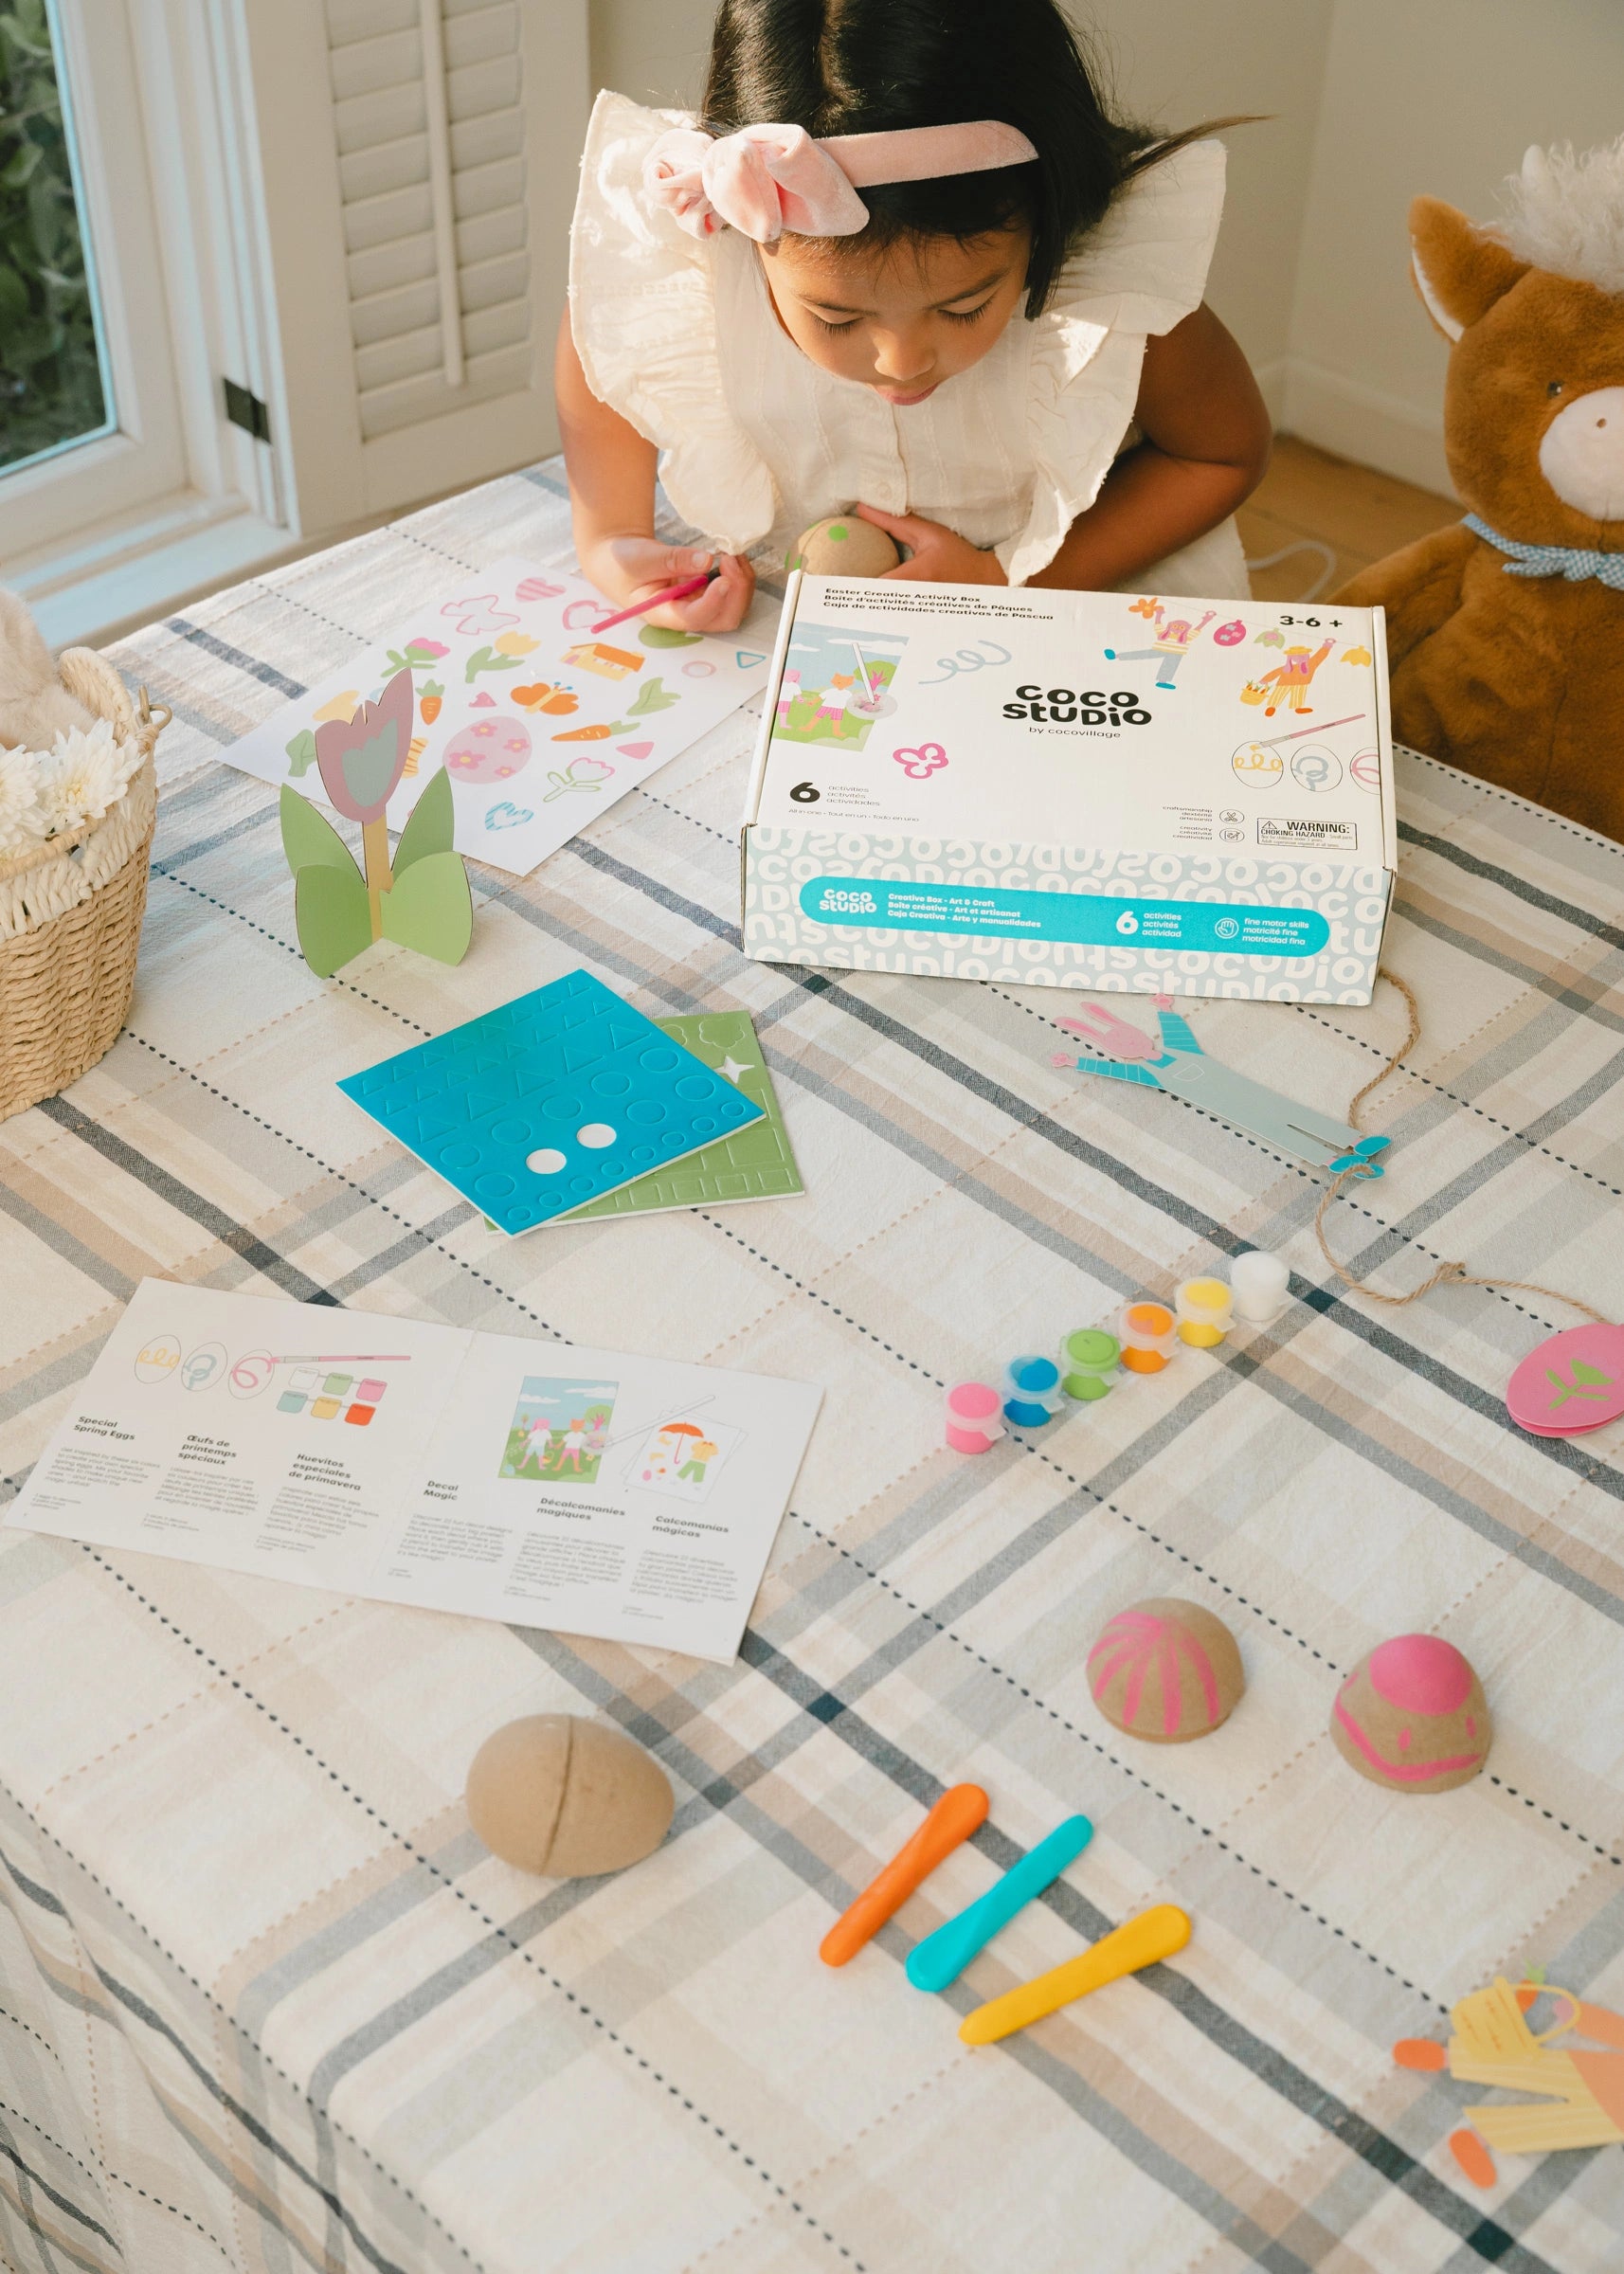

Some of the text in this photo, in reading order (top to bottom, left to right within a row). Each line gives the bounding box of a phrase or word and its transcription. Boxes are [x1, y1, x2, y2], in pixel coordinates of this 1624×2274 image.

[824, 587, 862, 596] Easter
[863, 590, 911, 599] Creative
[913, 593, 958, 602] Activity
[822, 601, 849, 609] Caja
[868, 604, 935, 614] actividades
[938, 607, 992, 617] creativas
[1012, 612, 1055, 621] Pascua
[918, 600, 971, 609] créatives
[991, 604, 1033, 613] Pâques
[1279, 615, 1321, 627] 3-6
[1048, 728, 1121, 739] cocovillage
[789, 782, 821, 803] 6
[826, 798, 880, 806] actividades
[1260, 828, 1294, 837] CHOKING
[1287, 821, 1350, 834] WARNING:
[888, 893, 925, 903] Creative
[927, 894, 943, 904] Box
[949, 896, 964, 906] Art
[972, 898, 996, 908] Craft
[888, 901, 910, 911] Boîte
[911, 903, 947, 912] créative
[955, 906, 968, 914] Art
[969, 907, 979, 915] et
[980, 907, 1020, 918] artisanat
[1144, 911, 1182, 921] activities
[887, 910, 908, 919] Caja
[909, 911, 946, 921] Creativa
[952, 914, 971, 923] Arte
[972, 916, 978, 925] y
[979, 916, 1042, 929] manualidades
[1115, 910, 1139, 935] 6
[1143, 920, 1180, 929] activités
[1244, 917, 1309, 929] fine motor skills
[1142, 929, 1182, 938] actividad
[1242, 927, 1299, 936] motricité fine
[1241, 934, 1306, 946] motricidad fina
[78, 1416, 118, 1428] Special
[74, 1424, 136, 1440] Spring Eggs
[181, 1443, 237, 1458] printemps
[177, 1452, 226, 1465] spéciaux
[297, 1453, 345, 1468] Huevitos
[293, 1462, 352, 1479] especiales
[288, 1471, 361, 1491] de primavera
[427, 1480, 460, 1491] Decal
[423, 1489, 459, 1501] Magic
[540, 1497, 626, 1517] Décalcomanies
[536, 1507, 592, 1521] magiques
[652, 1525, 701, 1538] mágicas
